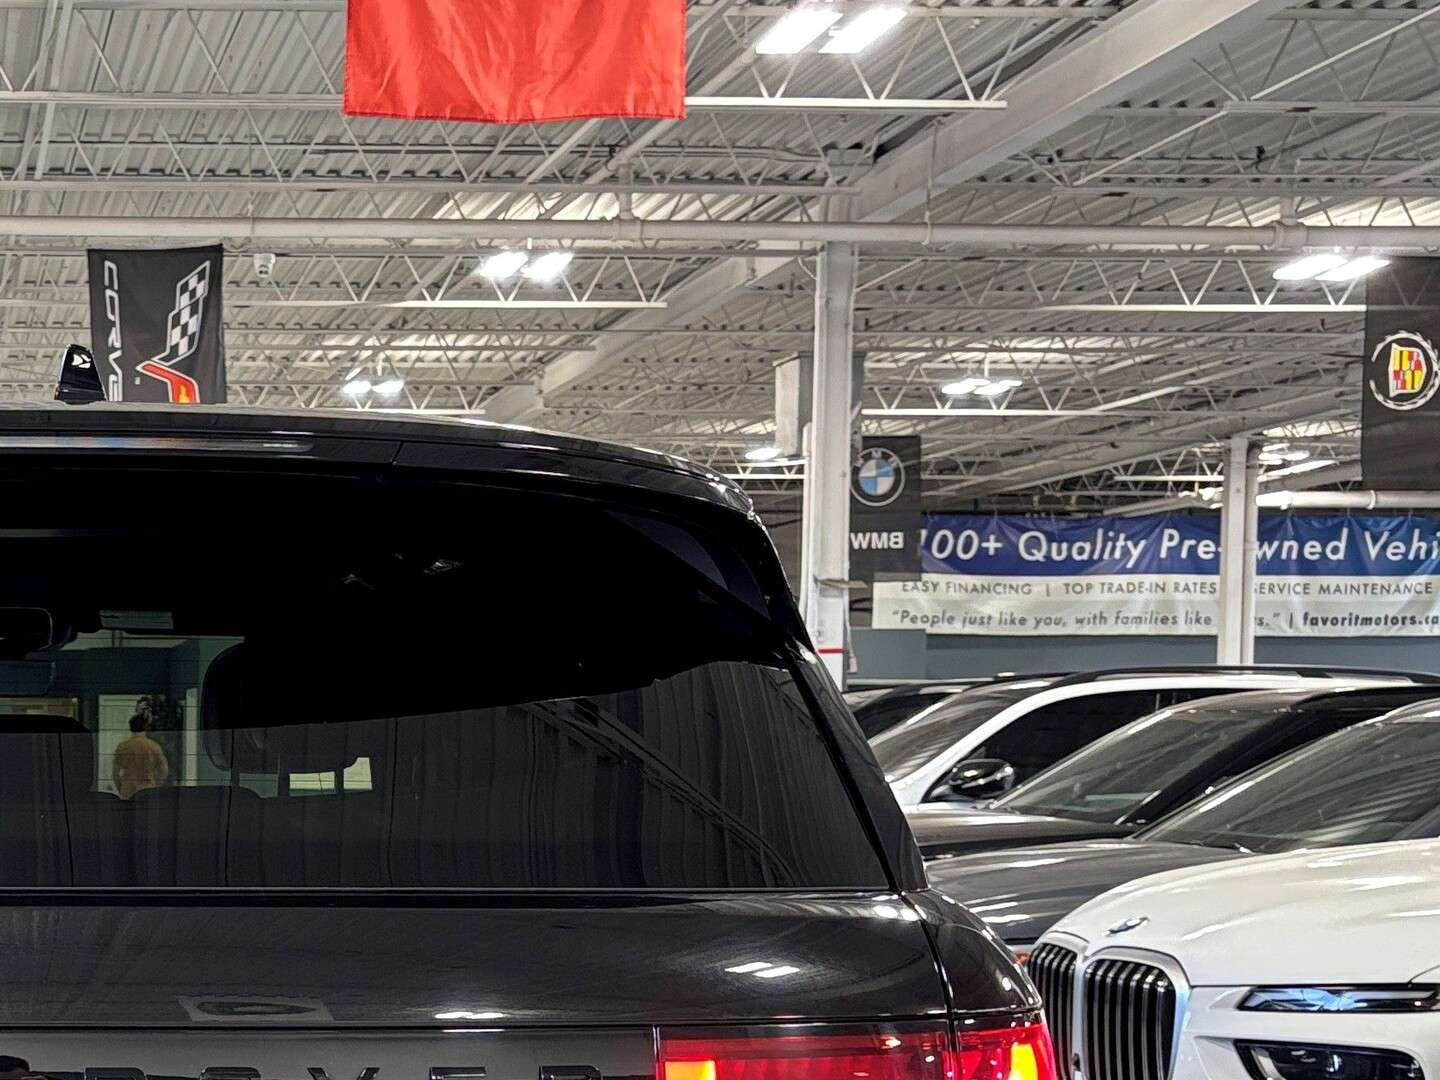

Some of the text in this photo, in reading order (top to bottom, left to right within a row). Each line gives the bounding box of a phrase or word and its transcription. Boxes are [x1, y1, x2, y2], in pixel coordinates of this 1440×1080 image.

[1017, 528, 1147, 569] Quality
[902, 581, 939, 593] EASY
[945, 581, 1033, 596] FINANCING
[1064, 582, 1094, 594] TOP
[1099, 581, 1166, 595] TRADE-IN
[1173, 581, 1218, 595] RATES
[1318, 582, 1433, 595] MAINTENANCE
[961, 609, 993, 628] just
[998, 609, 1027, 626] like
[1034, 613, 1067, 629] you,
[1075, 610, 1108, 626] with
[1114, 609, 1178, 626] families
[1184, 609, 1211, 626] like
[1303, 611, 1439, 627] favoritmotors.ca
